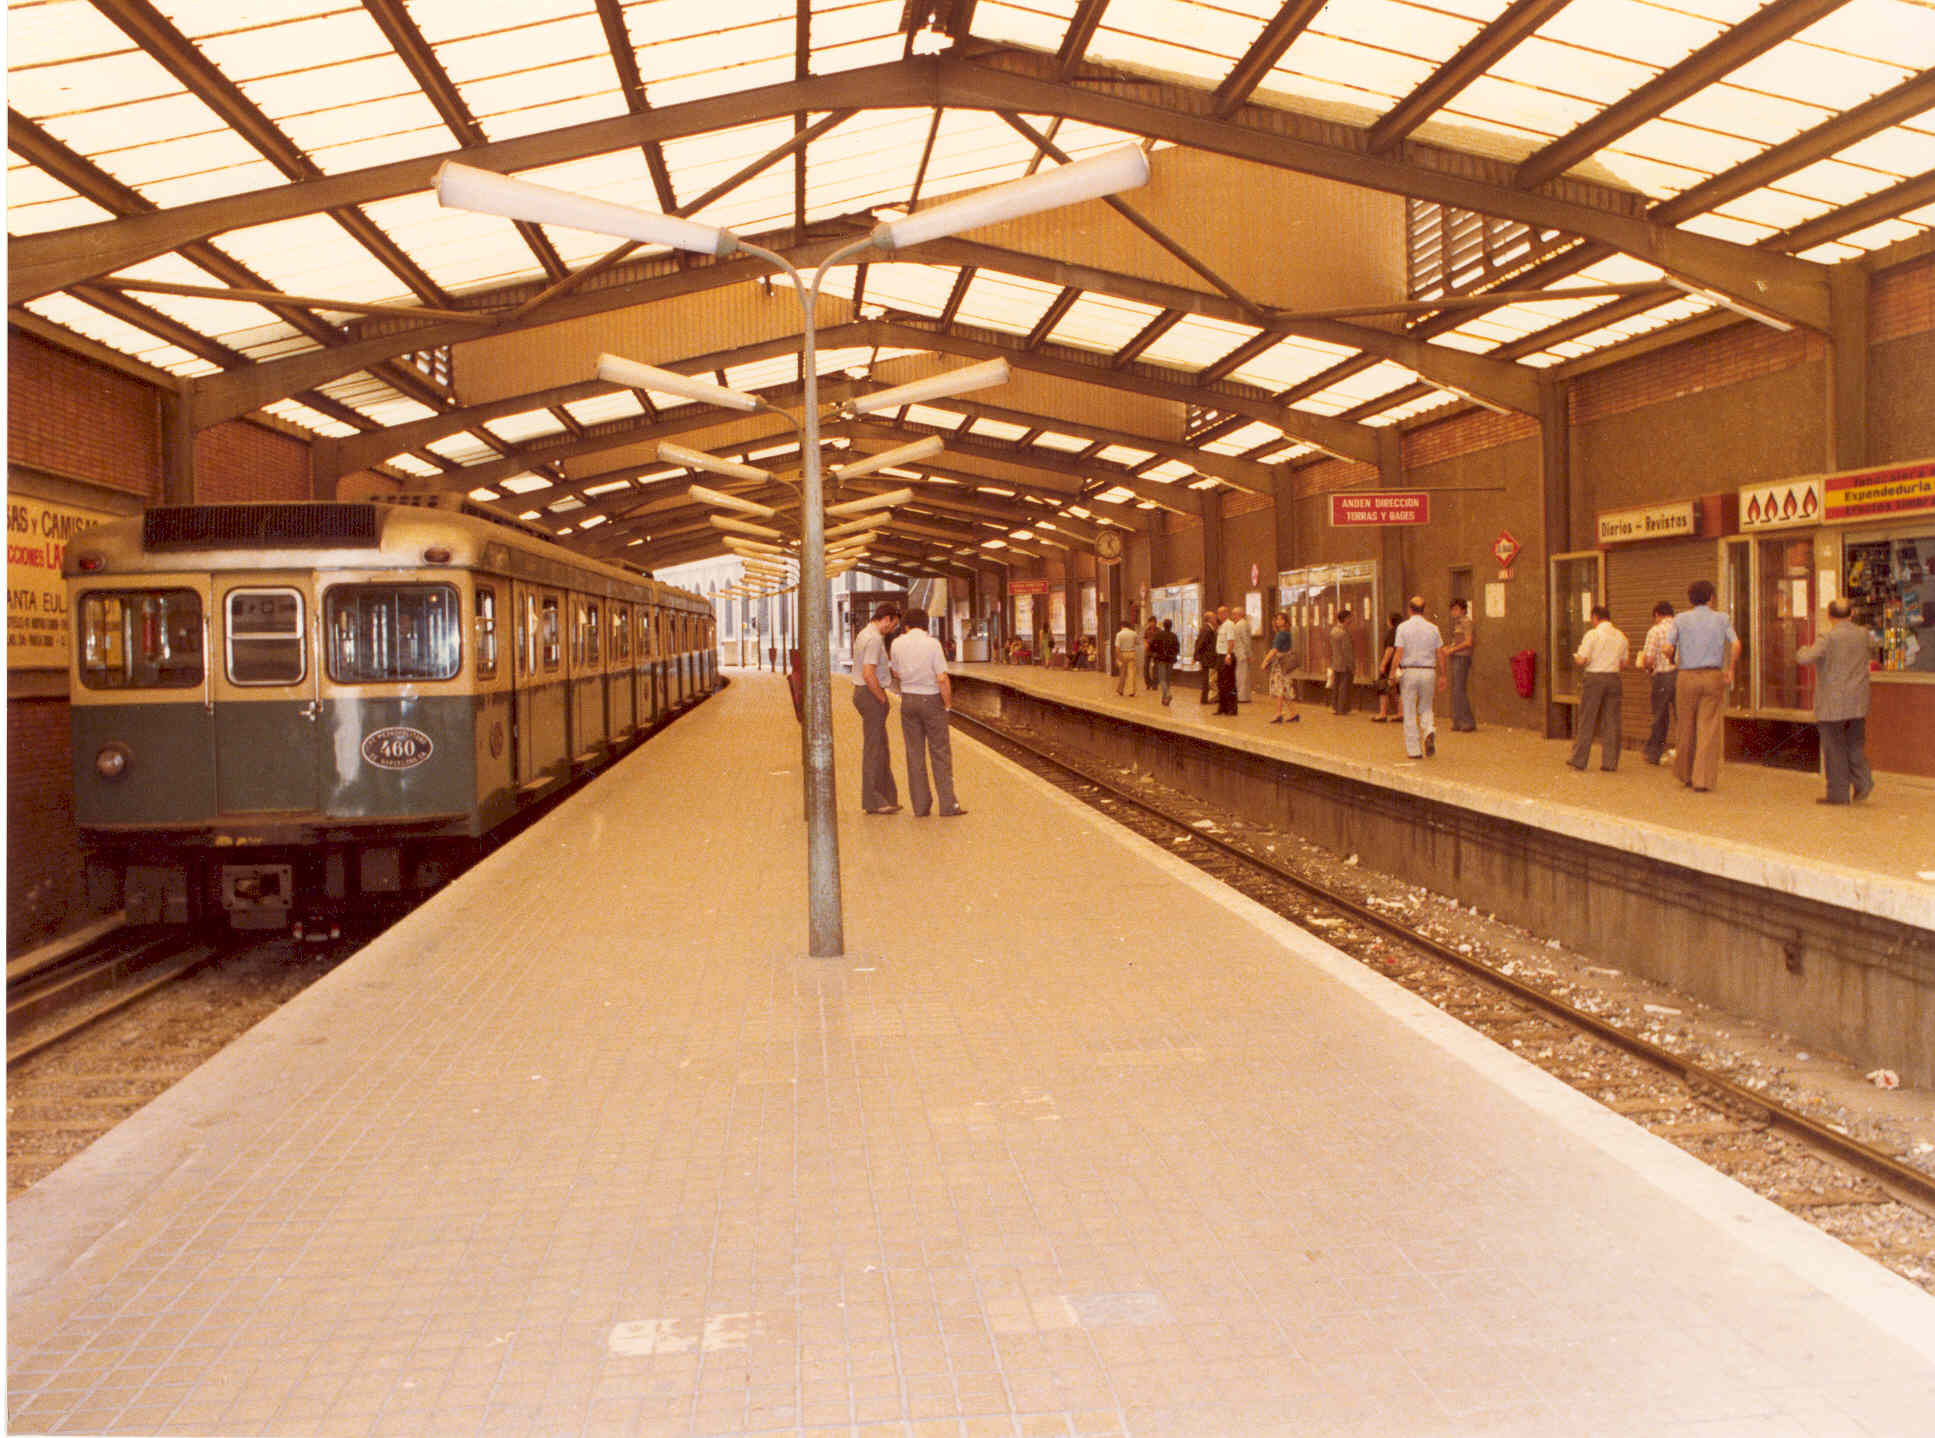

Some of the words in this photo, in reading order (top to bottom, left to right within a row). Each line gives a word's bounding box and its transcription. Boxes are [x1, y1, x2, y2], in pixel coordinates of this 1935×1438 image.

[1341, 498, 1371, 508] ANDEN
[1380, 511, 1388, 521] Y
[1601, 519, 1633, 537] Diarios
[1645, 514, 1688, 532] Revistas
[380, 739, 416, 758] 460
